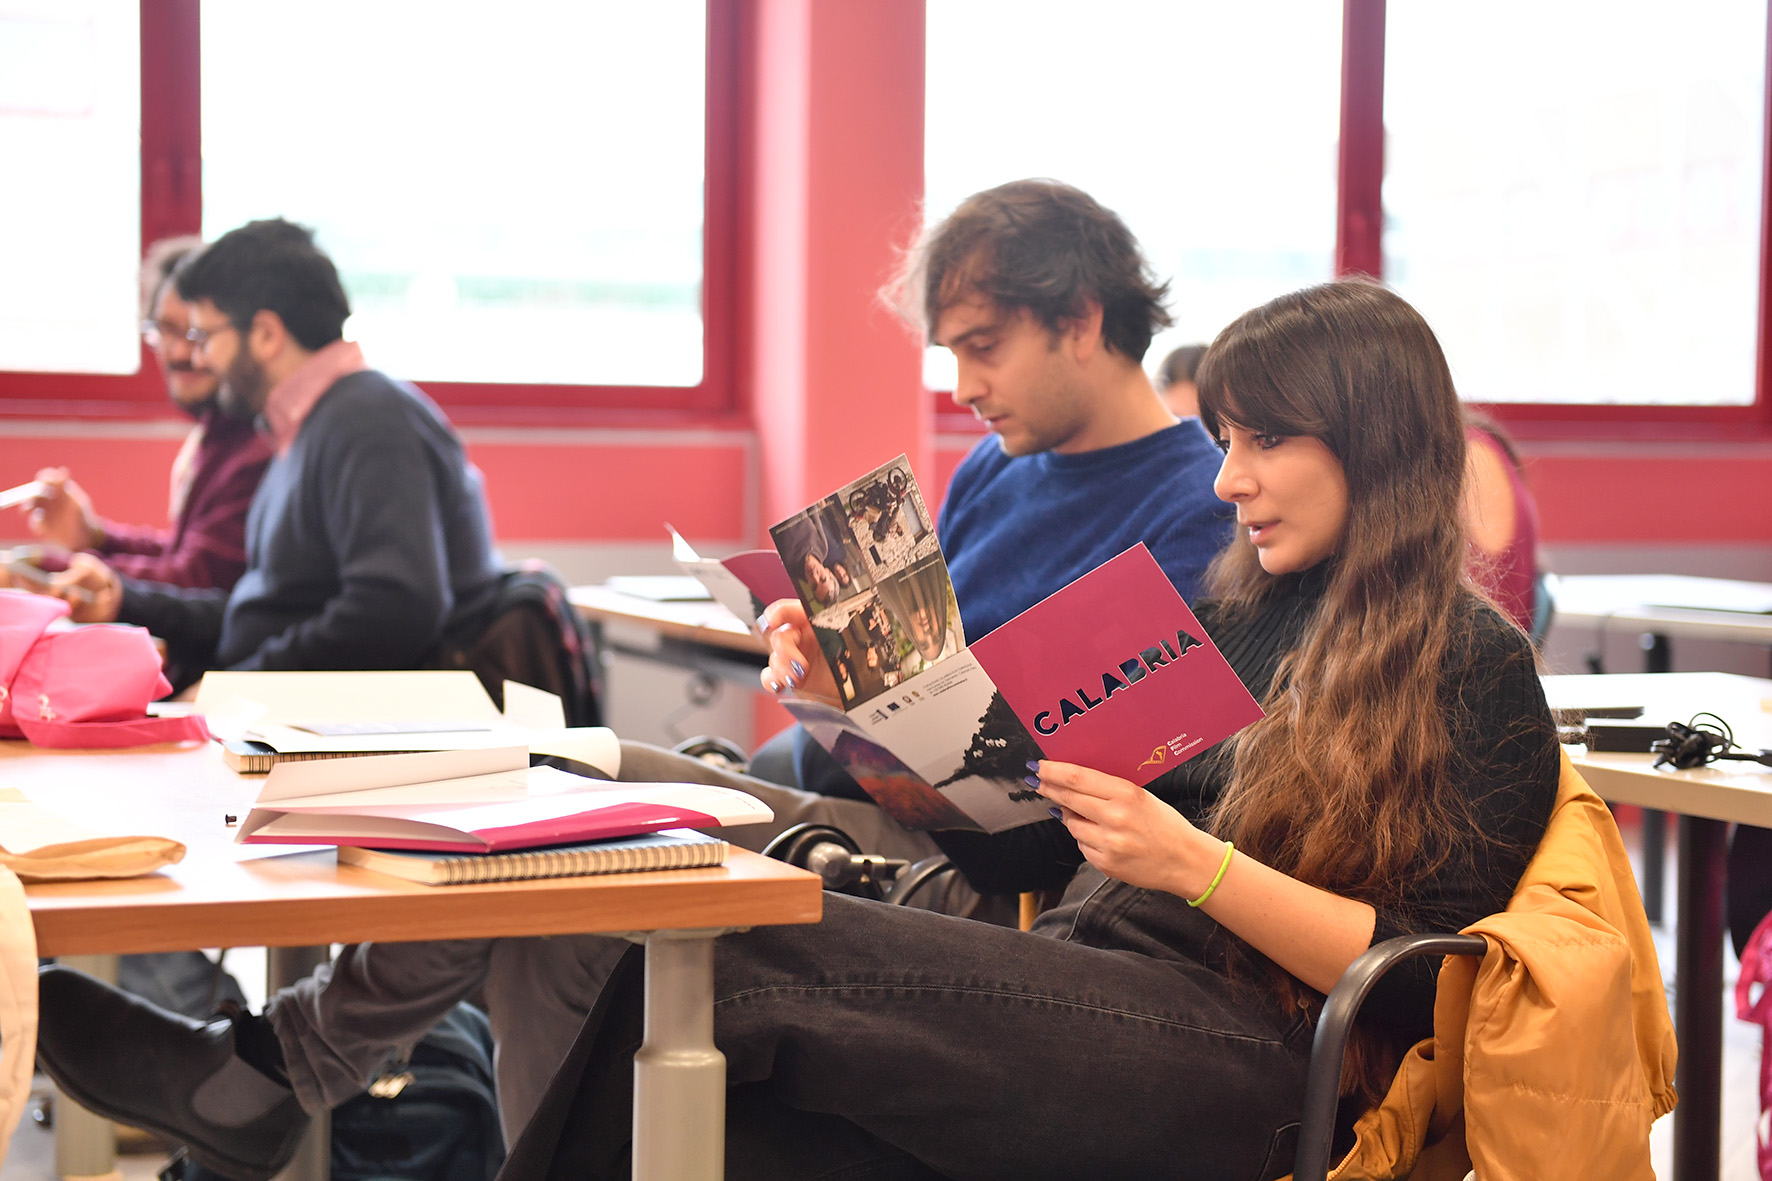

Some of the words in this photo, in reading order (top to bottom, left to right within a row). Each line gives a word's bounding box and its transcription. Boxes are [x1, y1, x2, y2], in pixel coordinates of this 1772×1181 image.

[1033, 629, 1204, 736] CALABRIA
[1166, 732, 1188, 747] Calabria
[1170, 742, 1183, 752] Film
[1173, 737, 1204, 756] Commission
